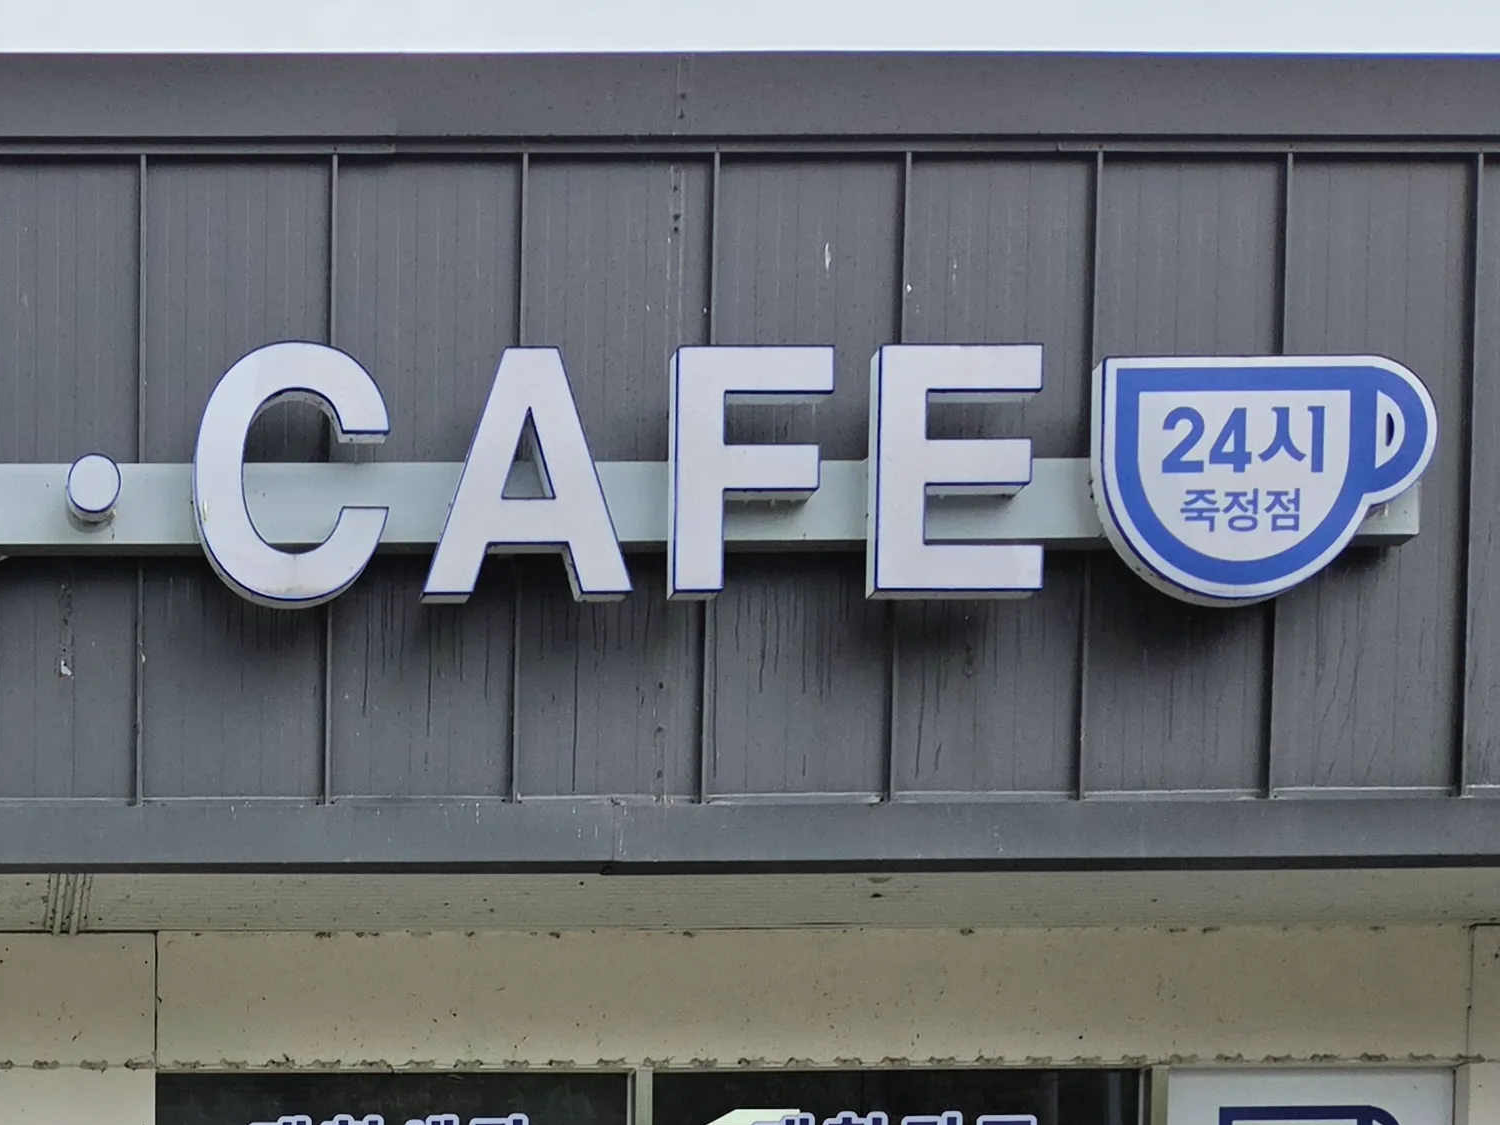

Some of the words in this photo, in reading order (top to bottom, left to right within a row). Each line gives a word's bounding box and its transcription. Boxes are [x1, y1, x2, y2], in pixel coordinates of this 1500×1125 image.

[194, 340, 1045, 606] CAFE
[1159, 403, 1326, 475] 24시
[1178, 487, 1303, 534] 죽정점
